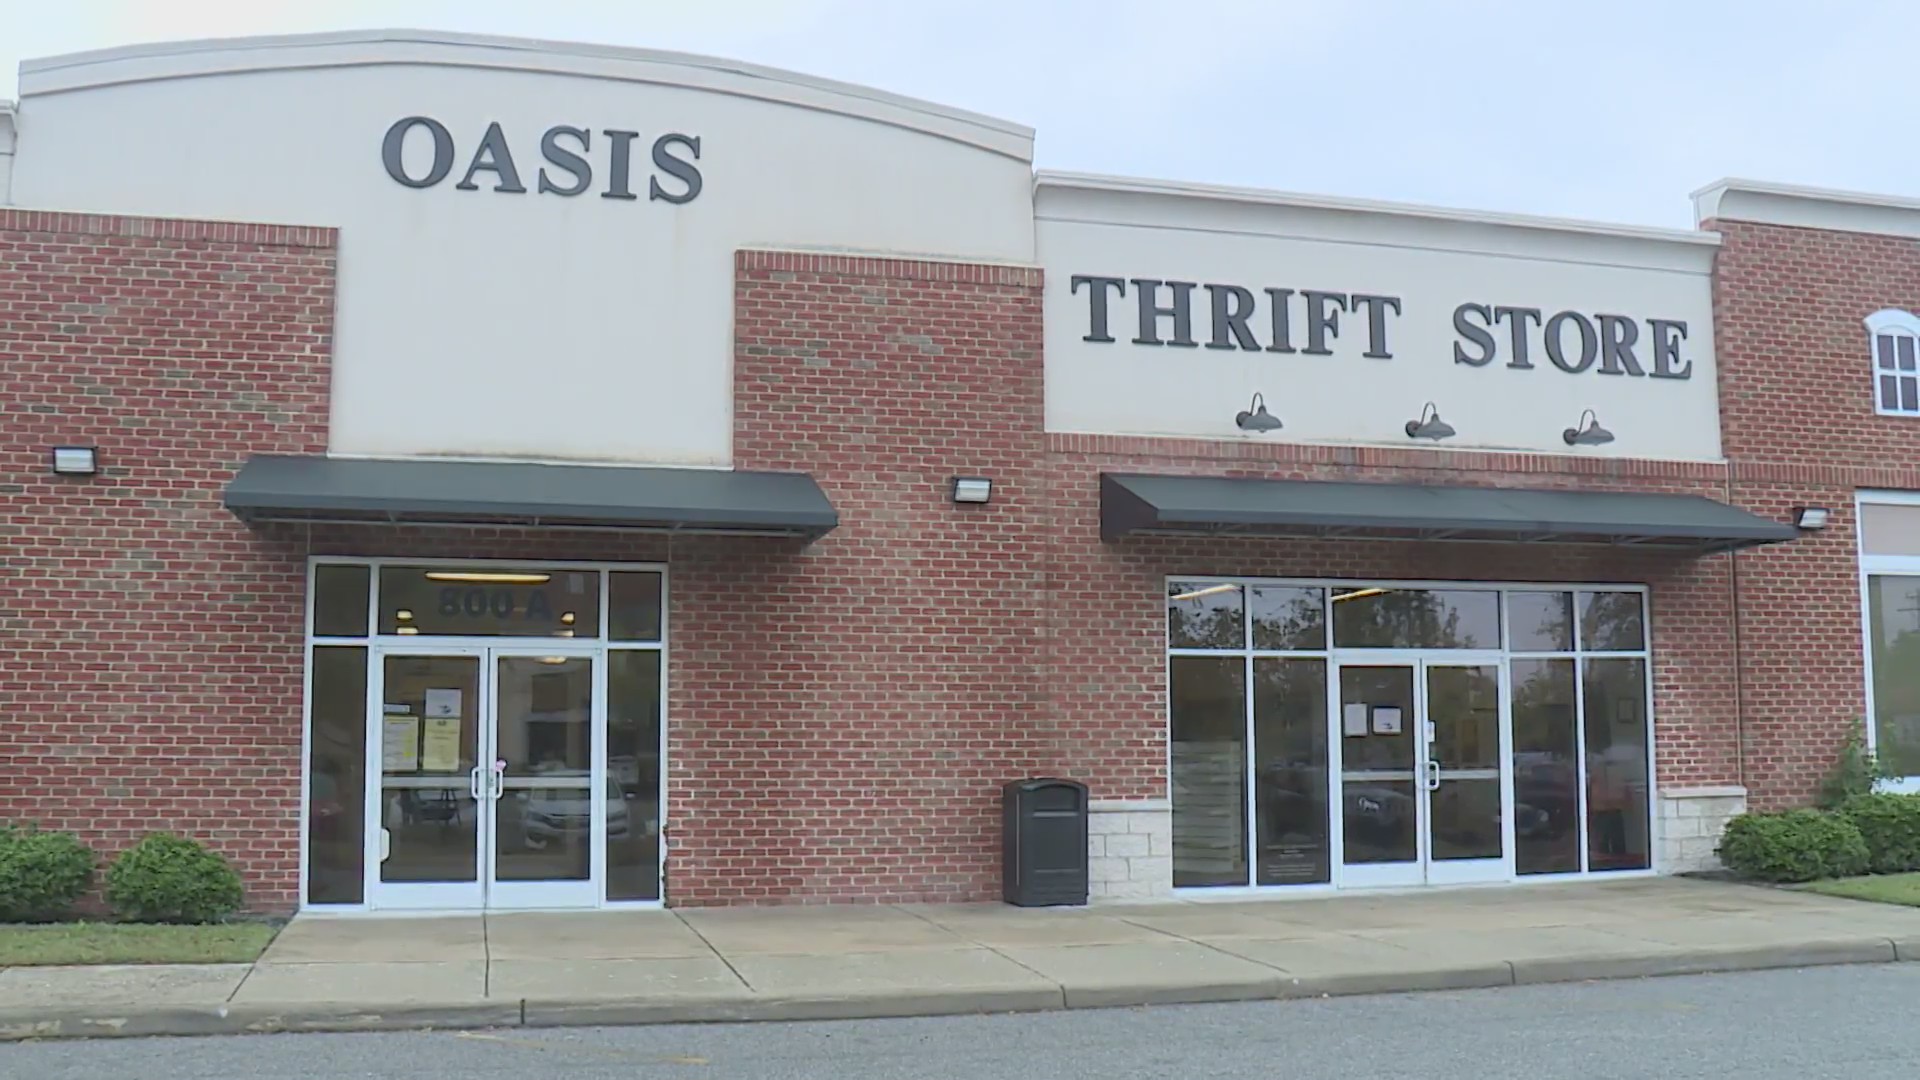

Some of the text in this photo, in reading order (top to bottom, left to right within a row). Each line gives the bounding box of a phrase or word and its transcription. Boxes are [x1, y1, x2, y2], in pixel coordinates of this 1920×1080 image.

[382, 117, 702, 204] OASIS
[1071, 276, 1691, 380] THRIFT STORE
